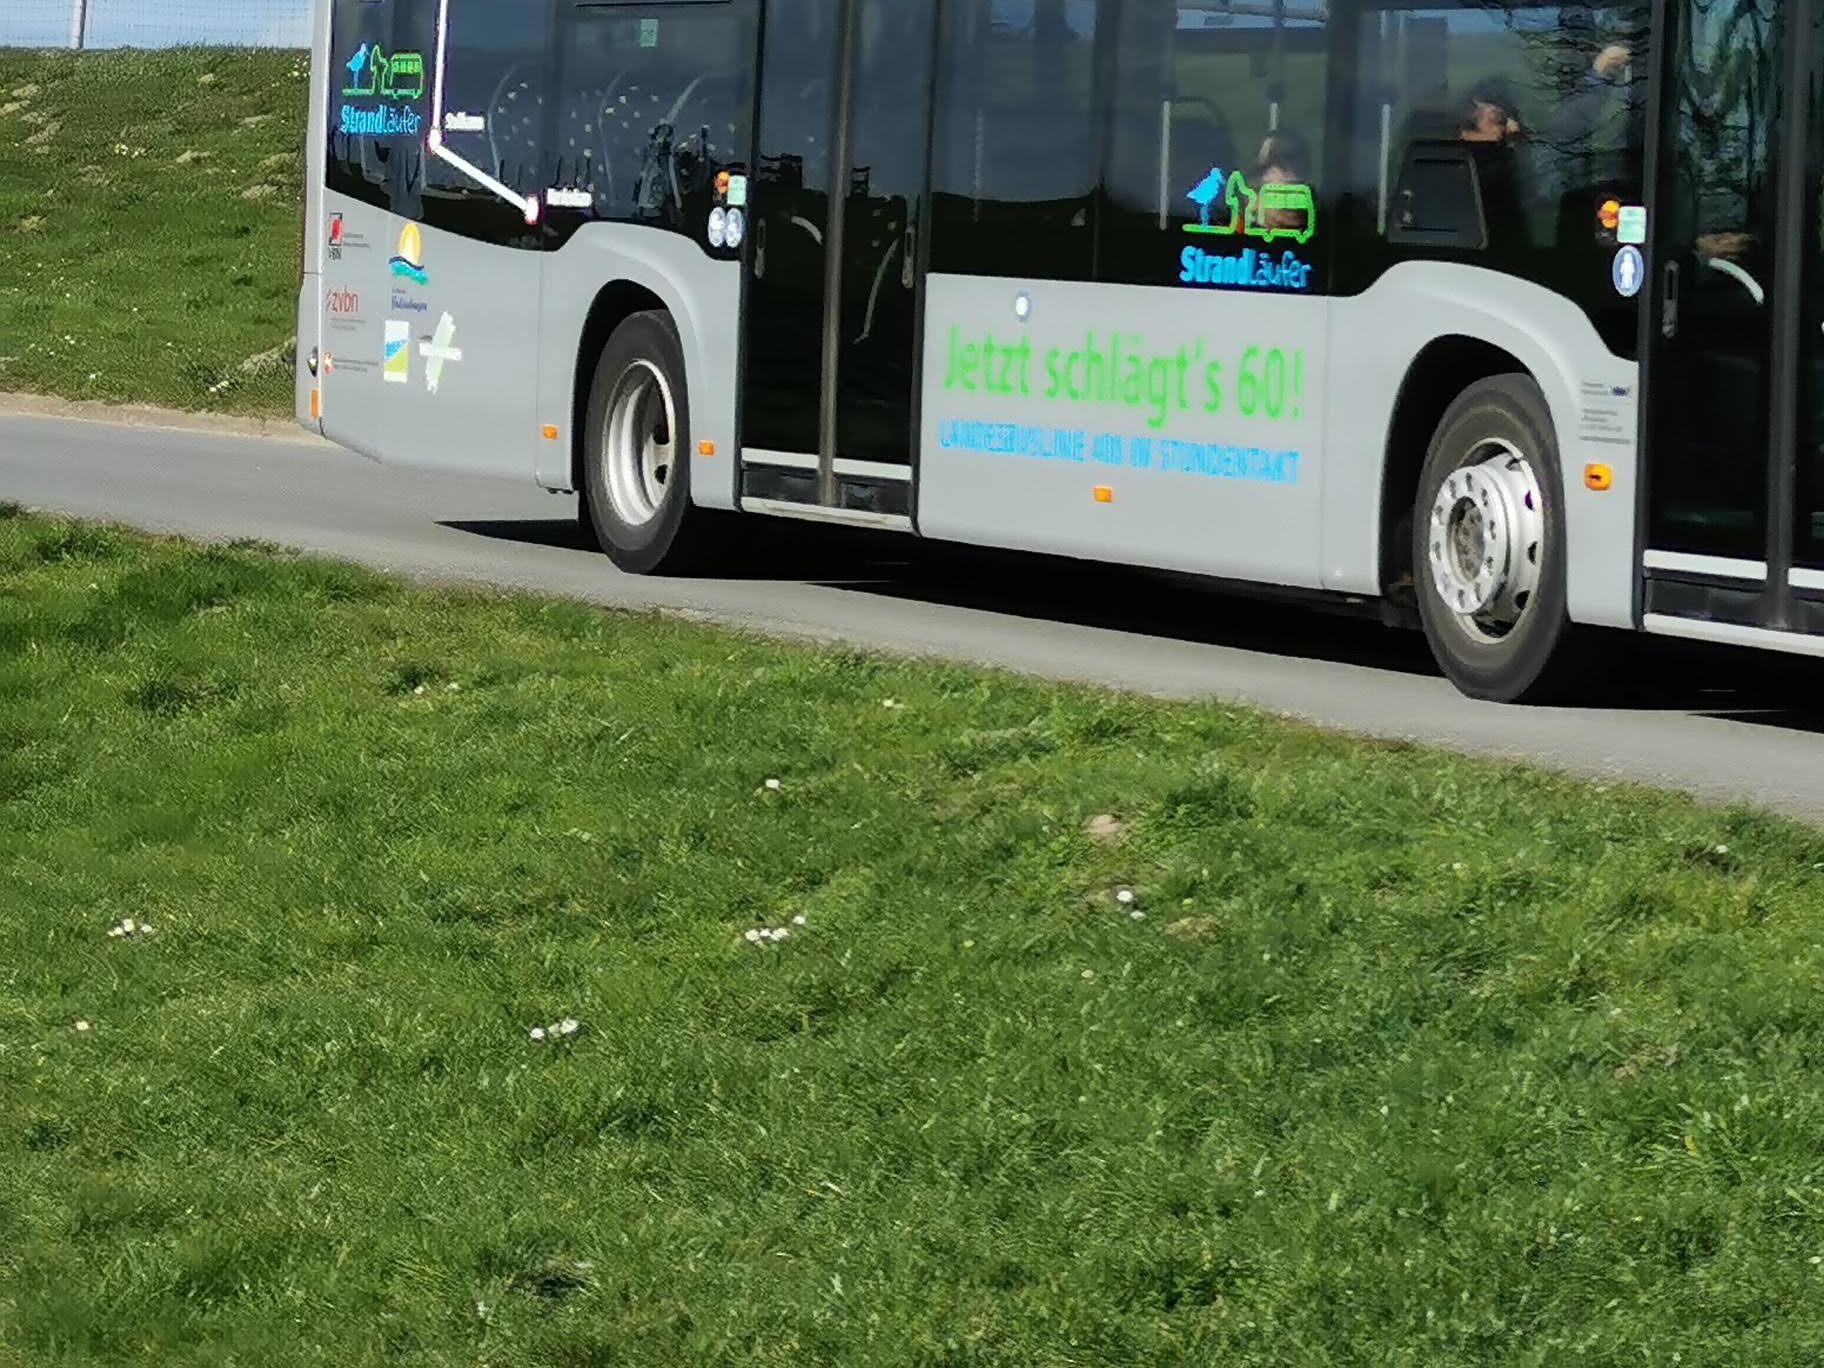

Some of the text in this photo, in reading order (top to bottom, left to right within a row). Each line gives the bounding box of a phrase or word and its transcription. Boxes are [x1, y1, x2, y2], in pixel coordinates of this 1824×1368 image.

[1179, 245, 1312, 288] StrandLäufer
[944, 324, 1304, 429] Jetzt schlägt's 60!
